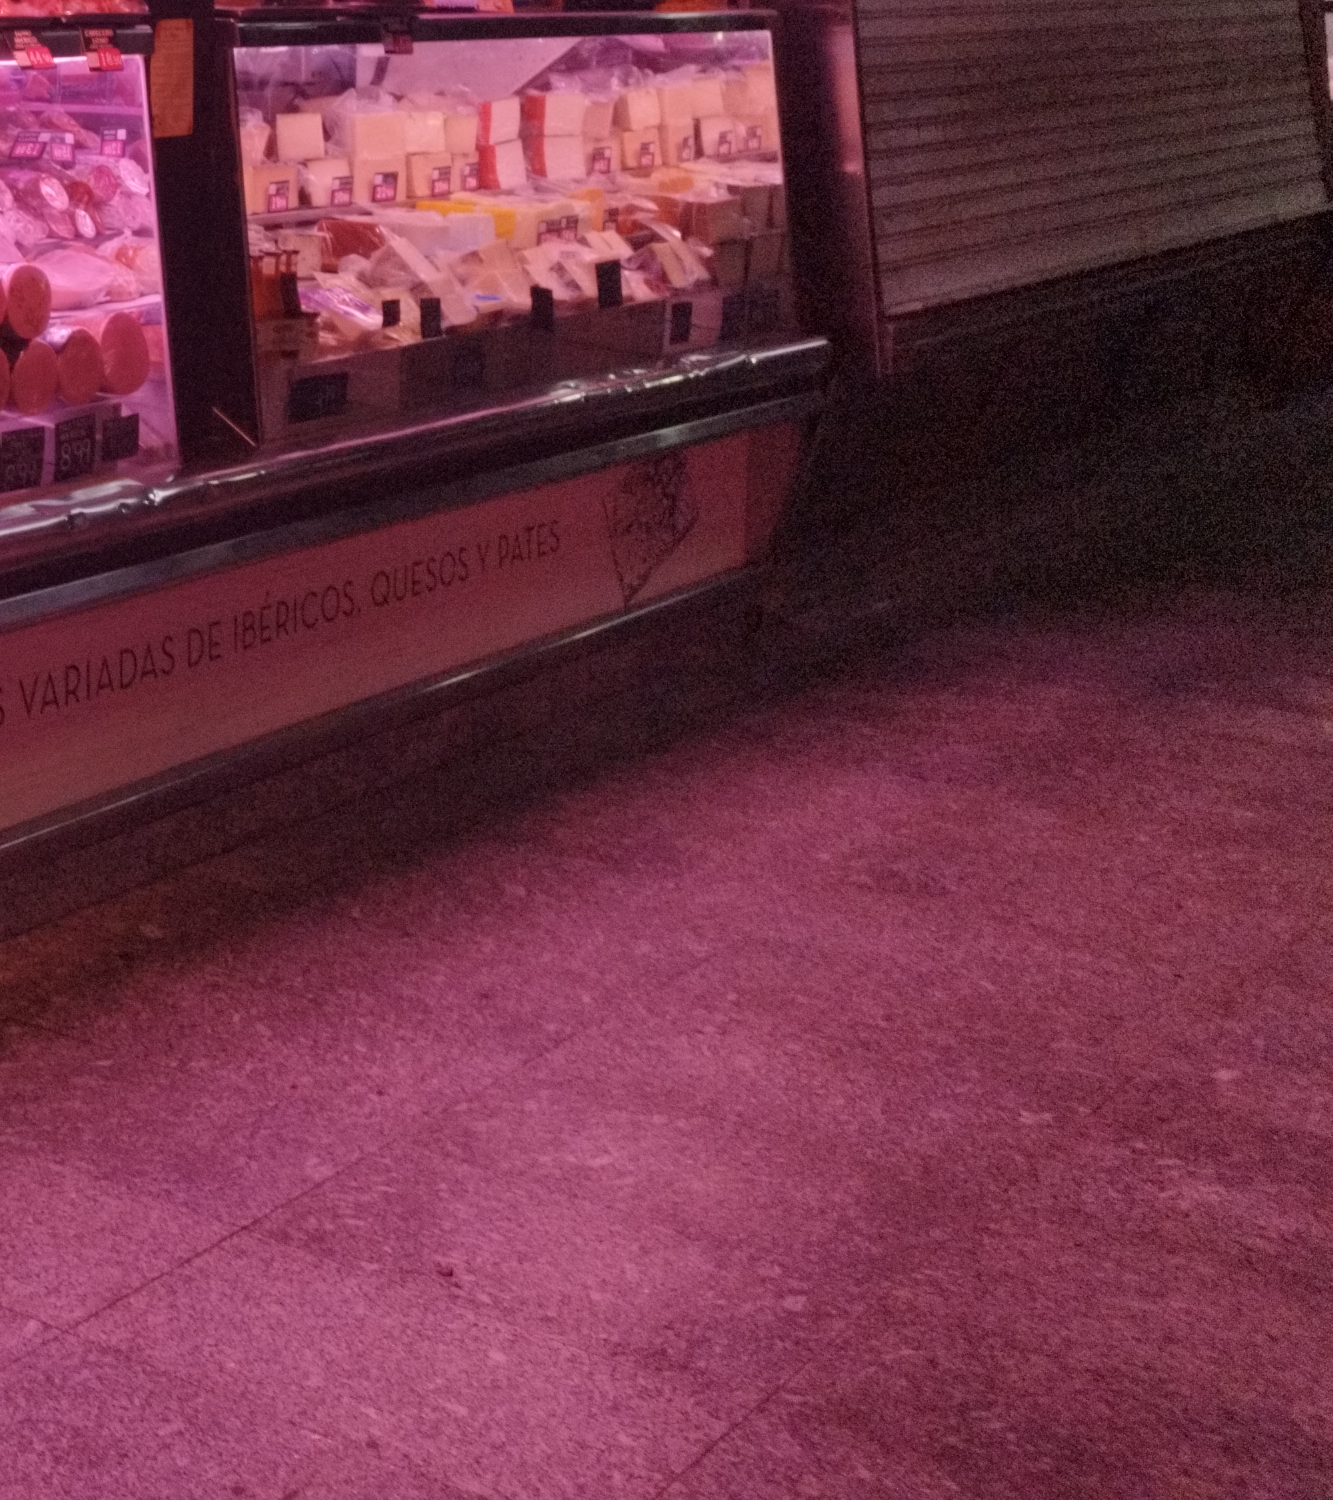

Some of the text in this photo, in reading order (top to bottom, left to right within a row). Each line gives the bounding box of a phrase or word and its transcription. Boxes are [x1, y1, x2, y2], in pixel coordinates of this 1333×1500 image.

[17, 634, 178, 719] VARIADAS
[185, 624, 225, 672] DE
[369, 545, 472, 612] QUESOS
[476, 542, 493, 576] Y
